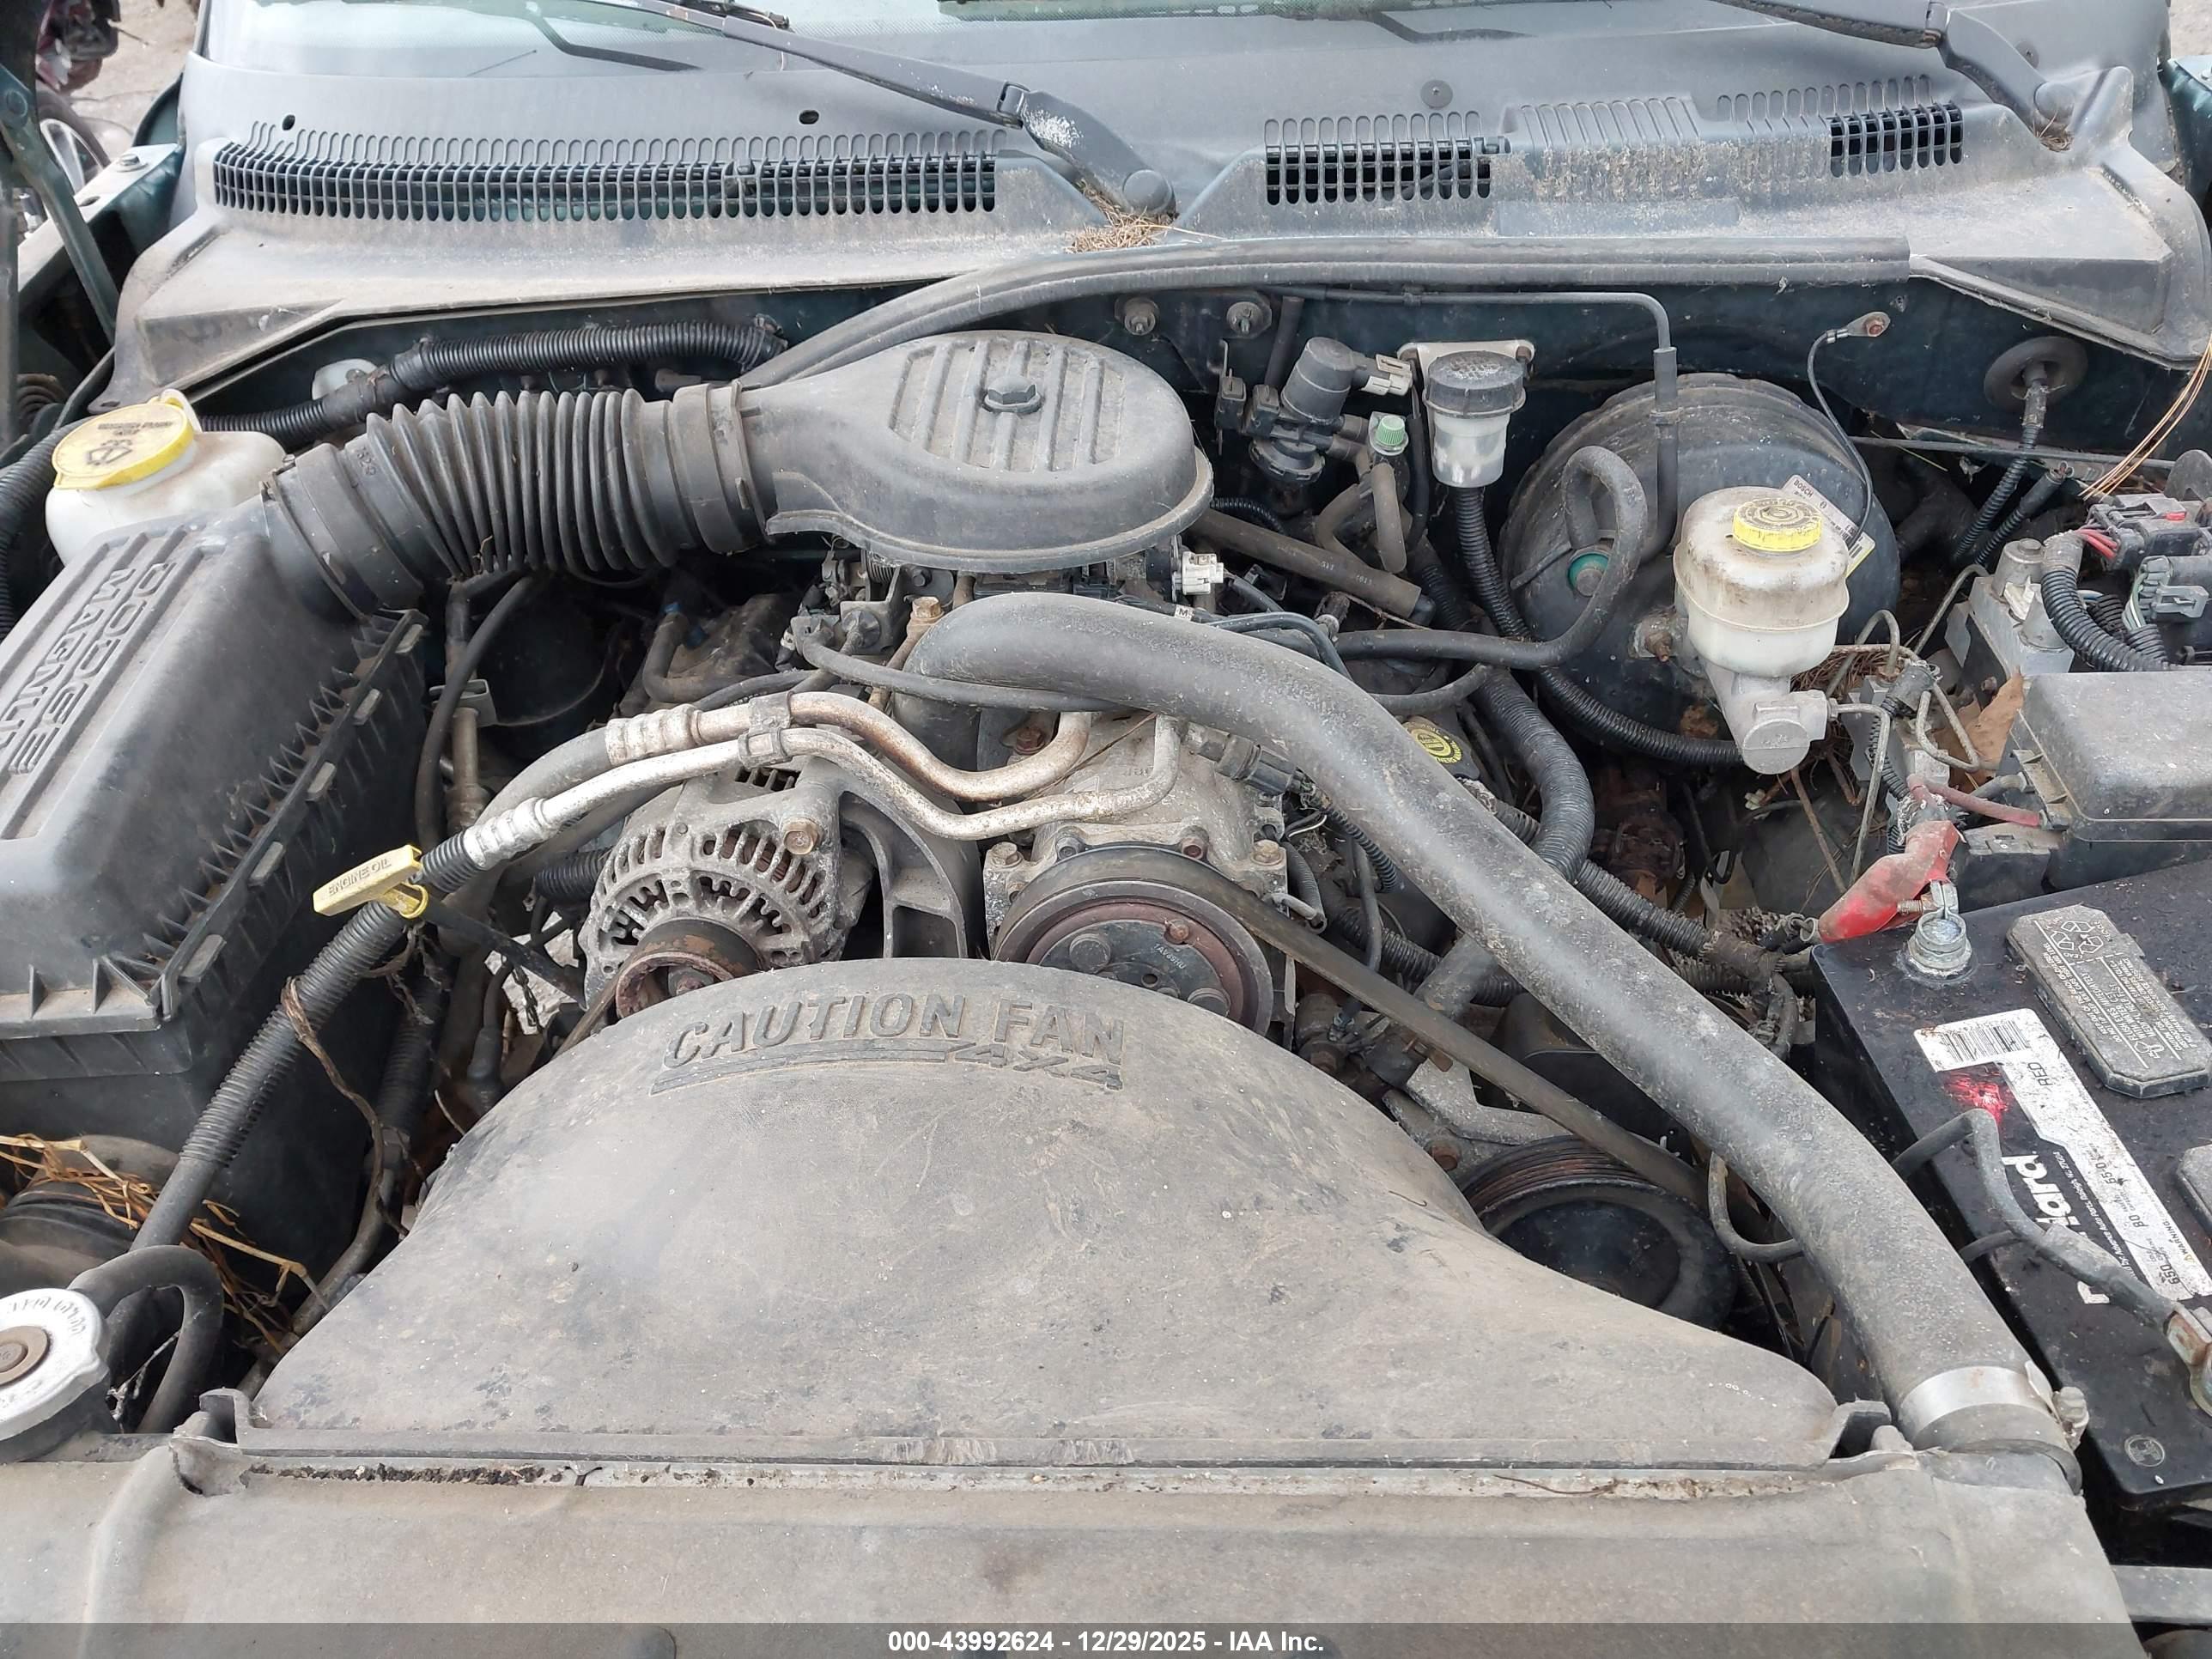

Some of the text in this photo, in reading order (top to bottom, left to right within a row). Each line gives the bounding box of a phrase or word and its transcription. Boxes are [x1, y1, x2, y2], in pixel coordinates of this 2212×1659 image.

[1793, 478, 1814, 498] BOSCH
[0, 568, 137, 750] MAGNU
[9, 562, 177, 774] DODGE
[327, 857, 392, 896] ENGINE OIL
[2078, 972, 2139, 1041] FLUSH EYES IMMEDIATELY
[2113, 1005, 2135, 1023] WATER
[2118, 998, 2136, 1011] HELP
[665, 992, 1125, 1069] CAUTION FAN
[2128, 1023, 2147, 1038] WITH
[2131, 1013, 2156, 1036] MEDICAL
[2026, 1060, 2053, 1086] RED
[2094, 1161, 2118, 1185] 65-0
[2093, 1217, 2107, 1231] Auto
[2127, 1213, 2144, 1228] 80
[2102, 1231, 2124, 1255] Advance
[2160, 1218, 2189, 1255] WARNING:
[2158, 1263, 2181, 1284] 650
